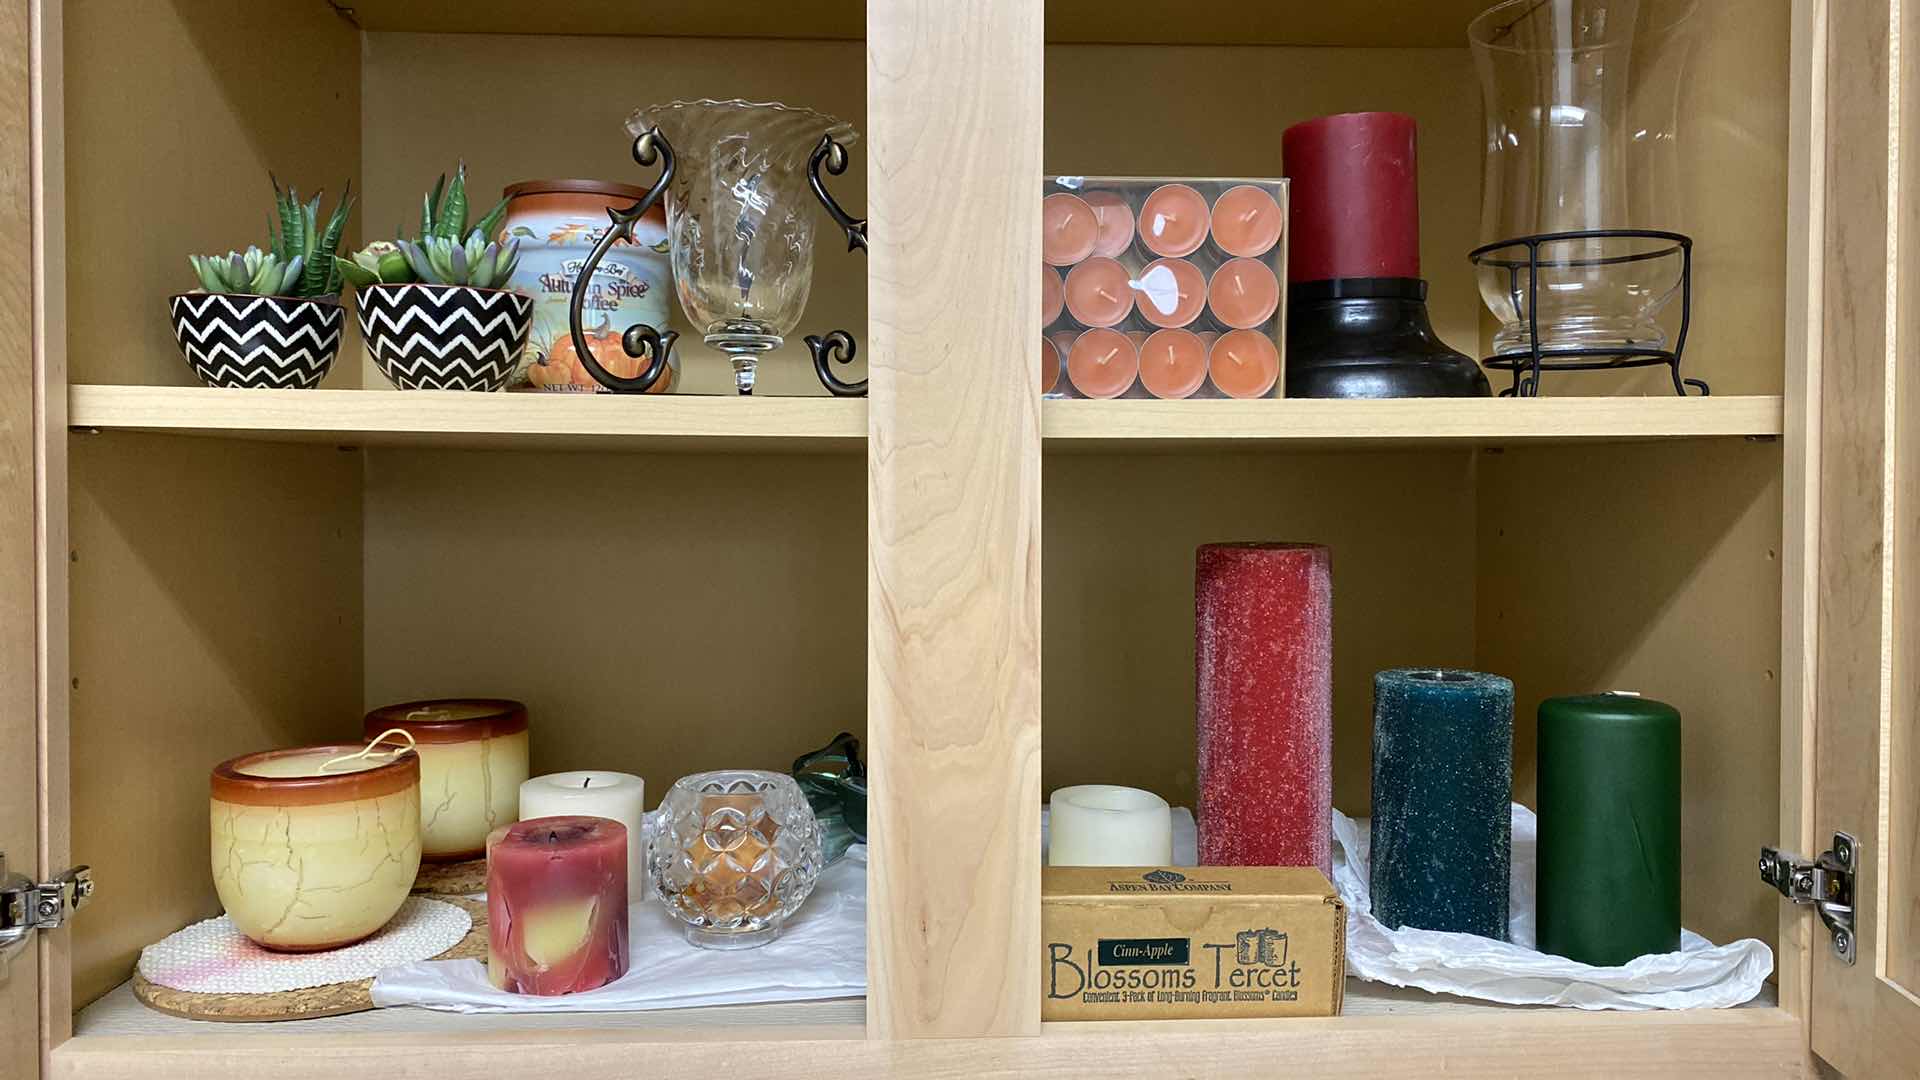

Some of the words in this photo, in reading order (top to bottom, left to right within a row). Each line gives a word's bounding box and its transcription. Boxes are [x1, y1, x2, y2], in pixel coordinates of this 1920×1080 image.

[608, 280, 649, 300] Spice
[582, 294, 618, 311] offee
[544, 384, 562, 392] NET
[1109, 882, 1147, 892] ASPEN
[1150, 882, 1174, 892] BAY
[1174, 882, 1232, 892] COMPANY
[1113, 943, 1173, 959] Cinn-Apple
[1047, 942, 1196, 999] Blossoms
[1202, 943, 1301, 989] Tercet
[1122, 991, 1146, 1003] 3-Pack
[1147, 990, 1155, 1002] of
[1157, 990, 1200, 1004] Long-Burning
